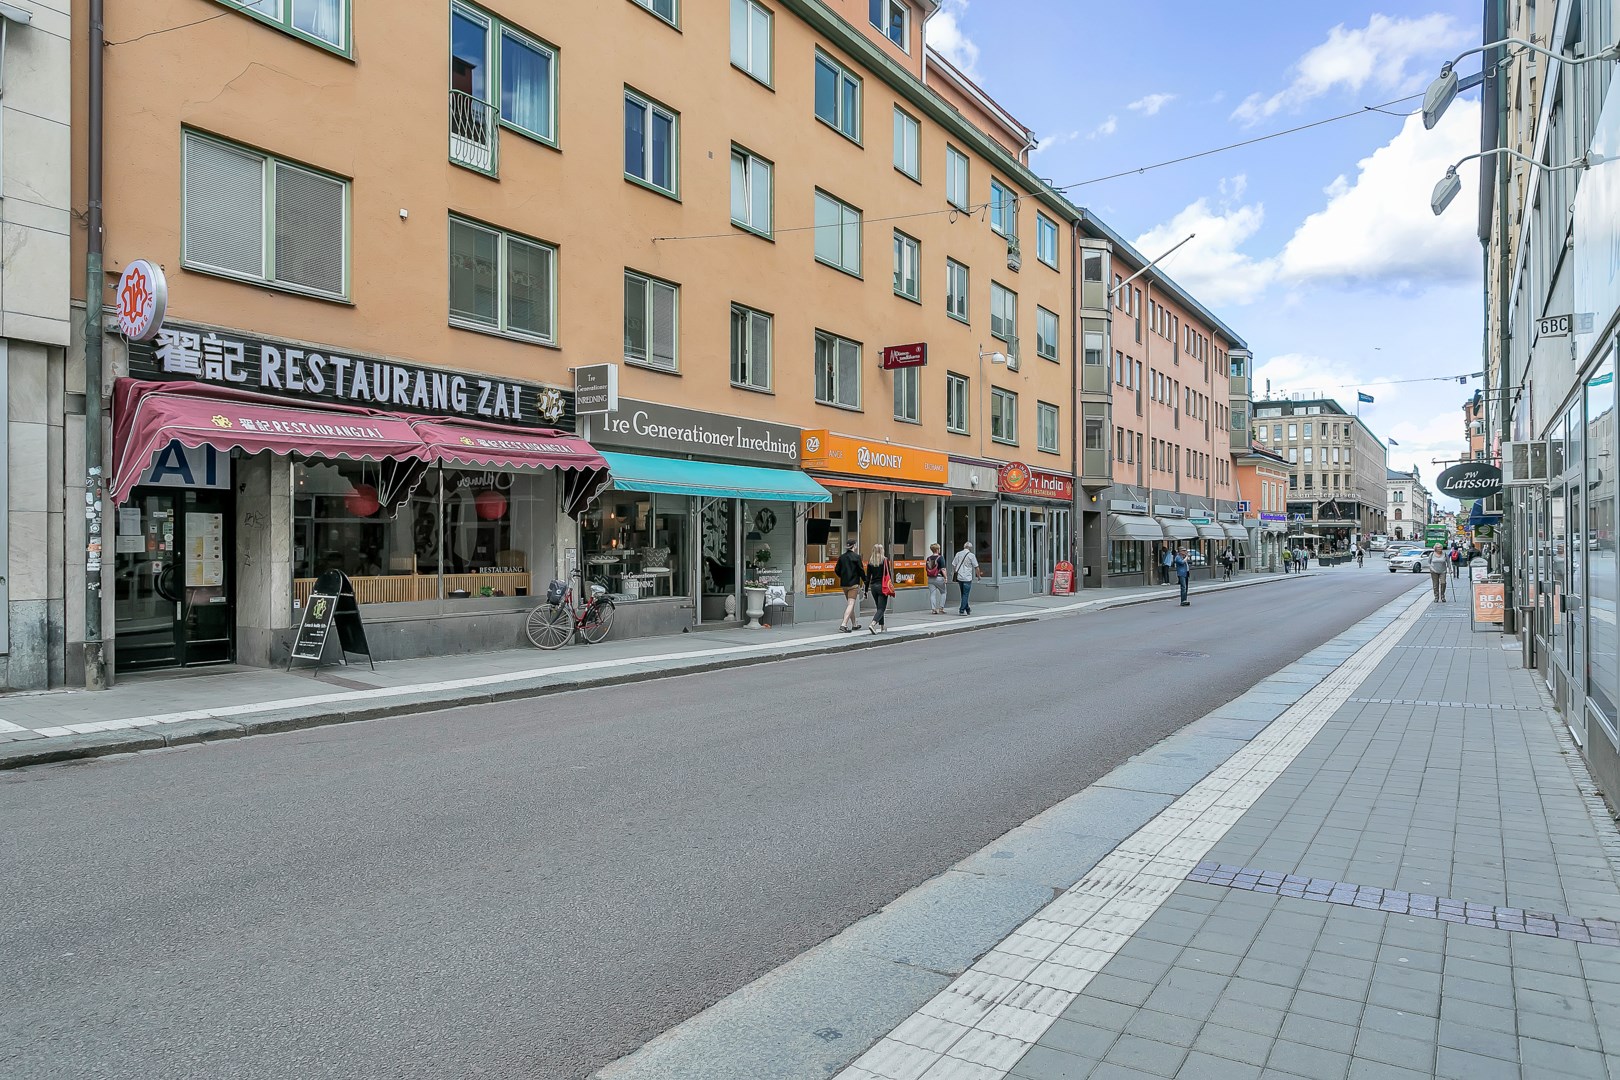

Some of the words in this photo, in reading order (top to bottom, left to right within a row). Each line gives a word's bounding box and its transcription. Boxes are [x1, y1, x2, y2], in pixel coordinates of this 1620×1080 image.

[1541, 317, 1568, 334] 6BC
[260, 344, 468, 413] RESTAURANG
[477, 379, 522, 420] ZAI
[632, 410, 734, 448] Generationer
[737, 426, 797, 460] Inredning
[828, 449, 843, 459] ANGE
[871, 452, 903, 469] MONEY
[148, 438, 218, 487] AI
[924, 462, 945, 473] EXCHANGE
[1041, 475, 1064, 491] India
[1443, 476, 1500, 490] Larsson
[479, 566, 523, 574] RESTAURANG
[817, 577, 836, 587] MONEY
